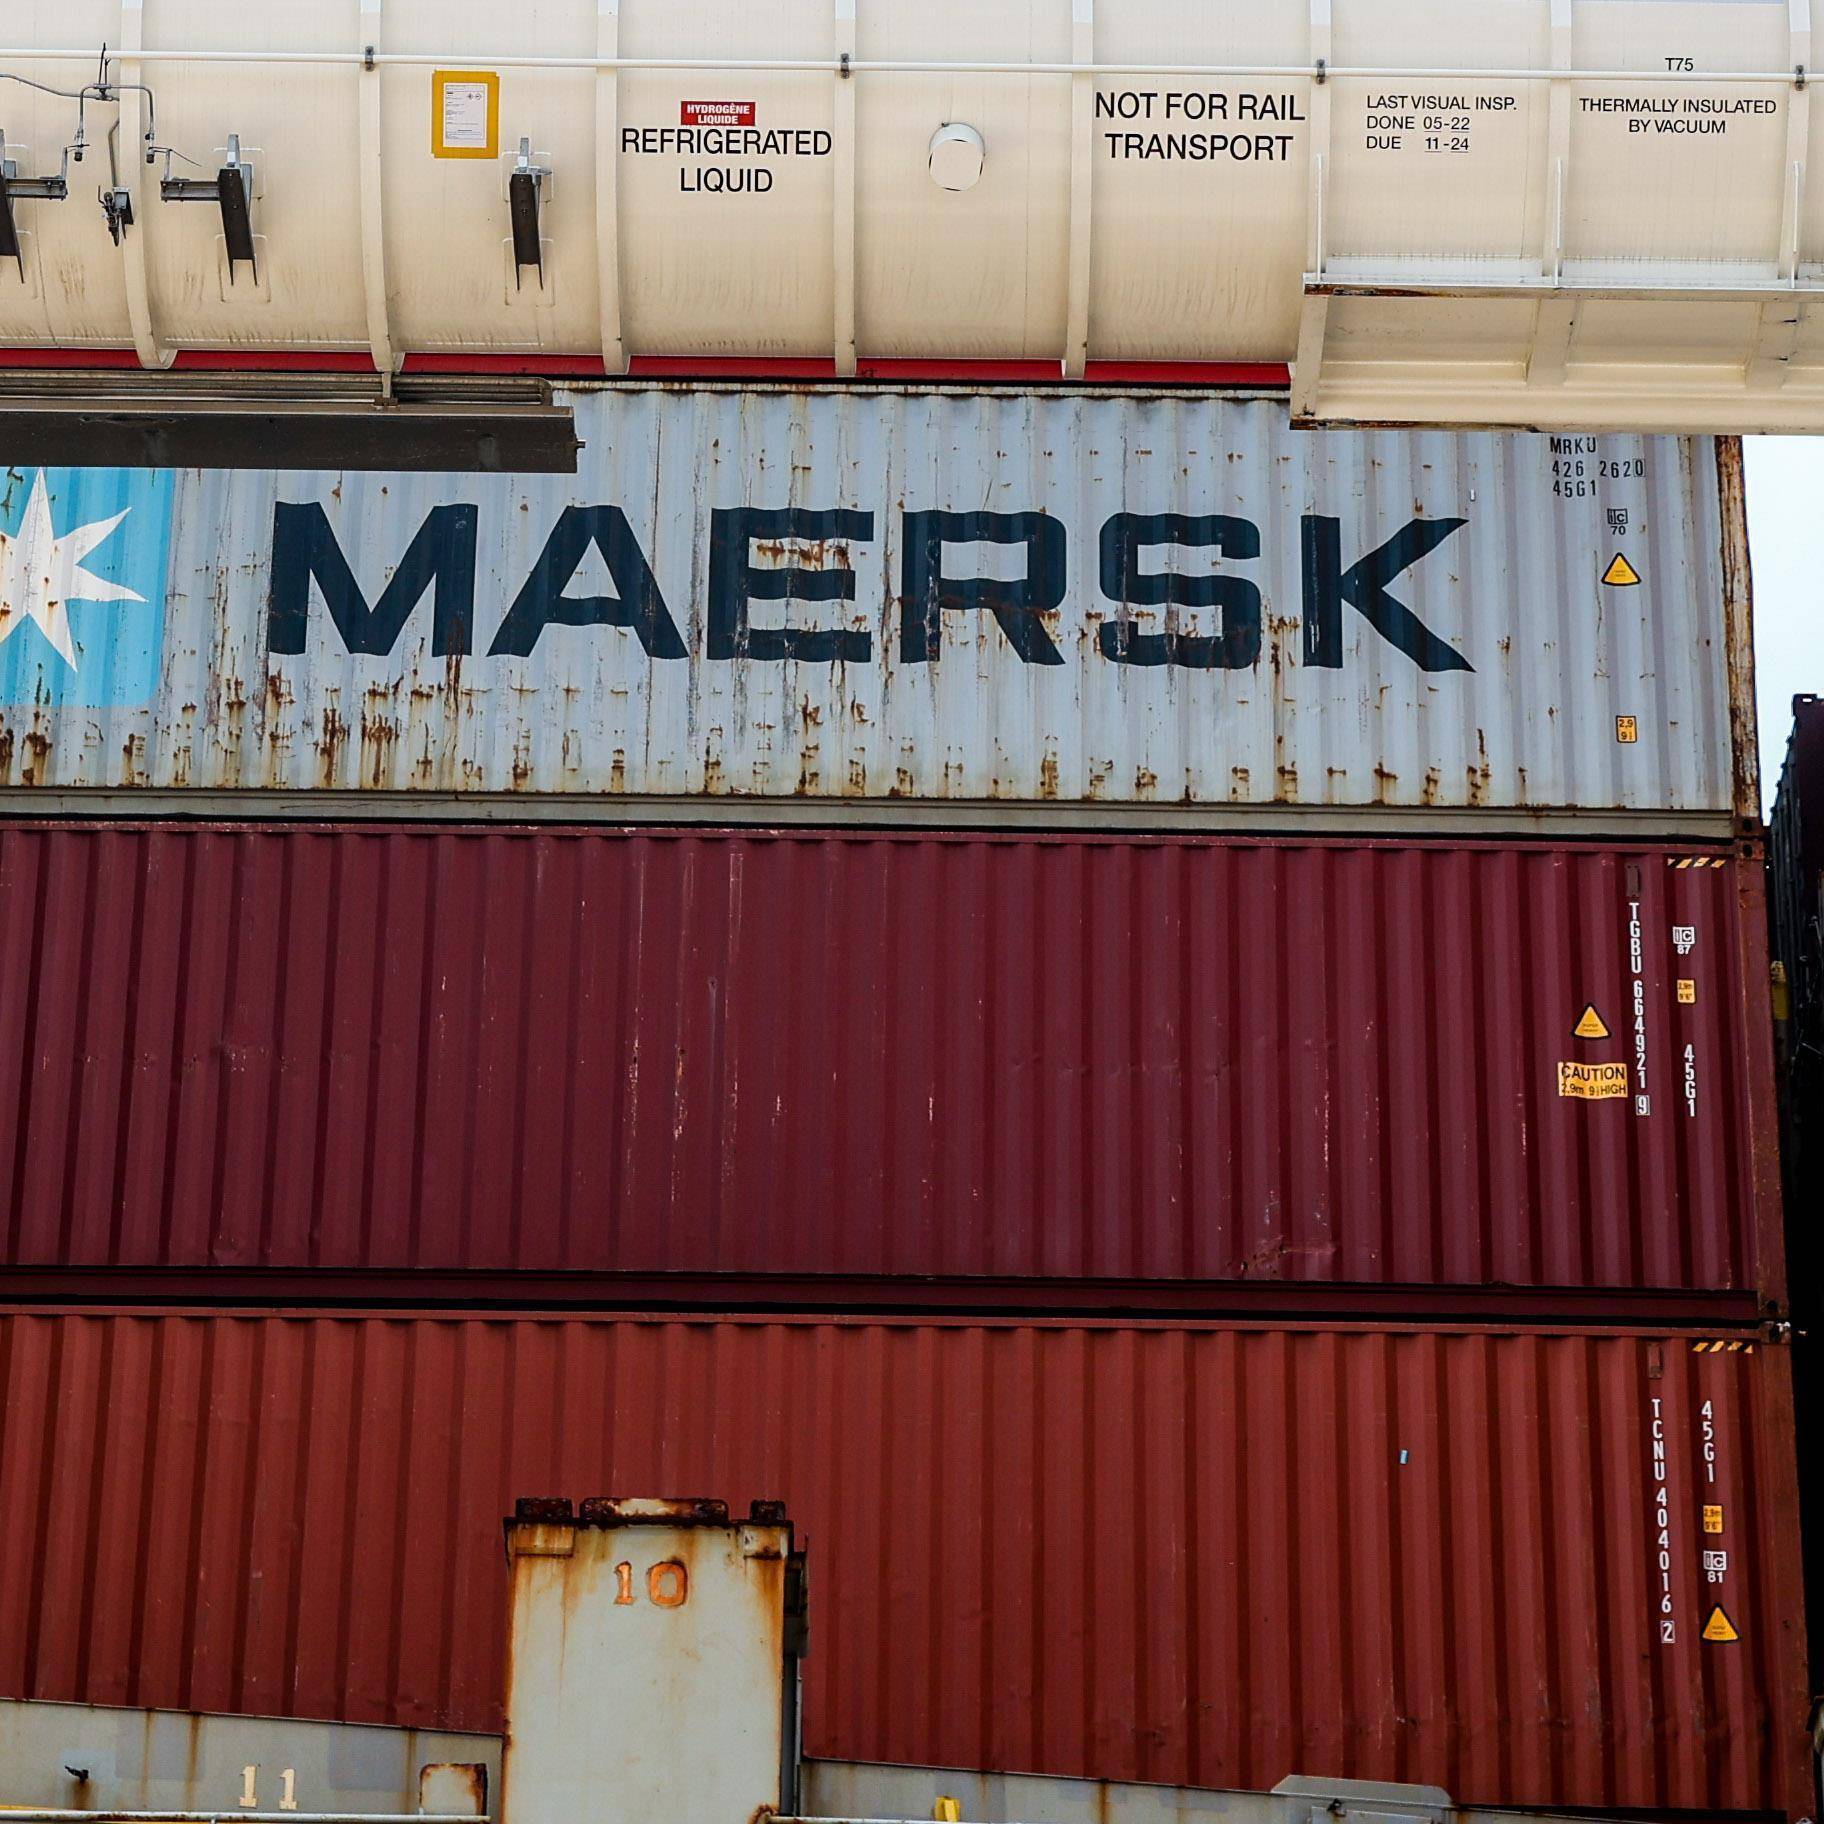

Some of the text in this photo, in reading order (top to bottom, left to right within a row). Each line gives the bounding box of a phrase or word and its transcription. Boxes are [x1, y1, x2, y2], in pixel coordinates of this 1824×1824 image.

[1665, 57, 1694, 72] T75
[1094, 91, 1306, 122] NOT FOR RAIL
[1367, 95, 1517, 111] LAST VISUAL INSP.
[1579, 98, 1777, 114] THERMALLY INSULATED
[697, 115, 738, 125] LIQUIDE
[1367, 116, 1415, 130] DONE
[1629, 119, 1726, 134] BY VACUUM
[622, 128, 832, 155] REFRIGERATED
[1106, 133, 1294, 162] TRANSPORT
[1366, 136, 1402, 149] DUE
[681, 167, 773, 193] LIQUID
[1550, 436, 1596, 455] MRKU
[1552, 459, 1644, 478] 426 2620
[1552, 479, 1596, 498] 45G1
[1610, 525, 1626, 535] 70
[267, 500, 1476, 673] MAERSK
[1629, 902, 1642, 973] TGBU
[1633, 980, 1646, 1088] 664921
[1562, 1065, 1626, 1081] CAUTION
[1684, 1044, 1697, 1117] 45G1
[1651, 1398, 1665, 1481] TCNU
[1701, 1400, 1715, 1483] 45G1
[1656, 1487, 1672, 1614] 404016
[614, 1559, 689, 1609] 10
[1707, 1571, 1723, 1583] 81
[239, 1765, 298, 1810] 11
